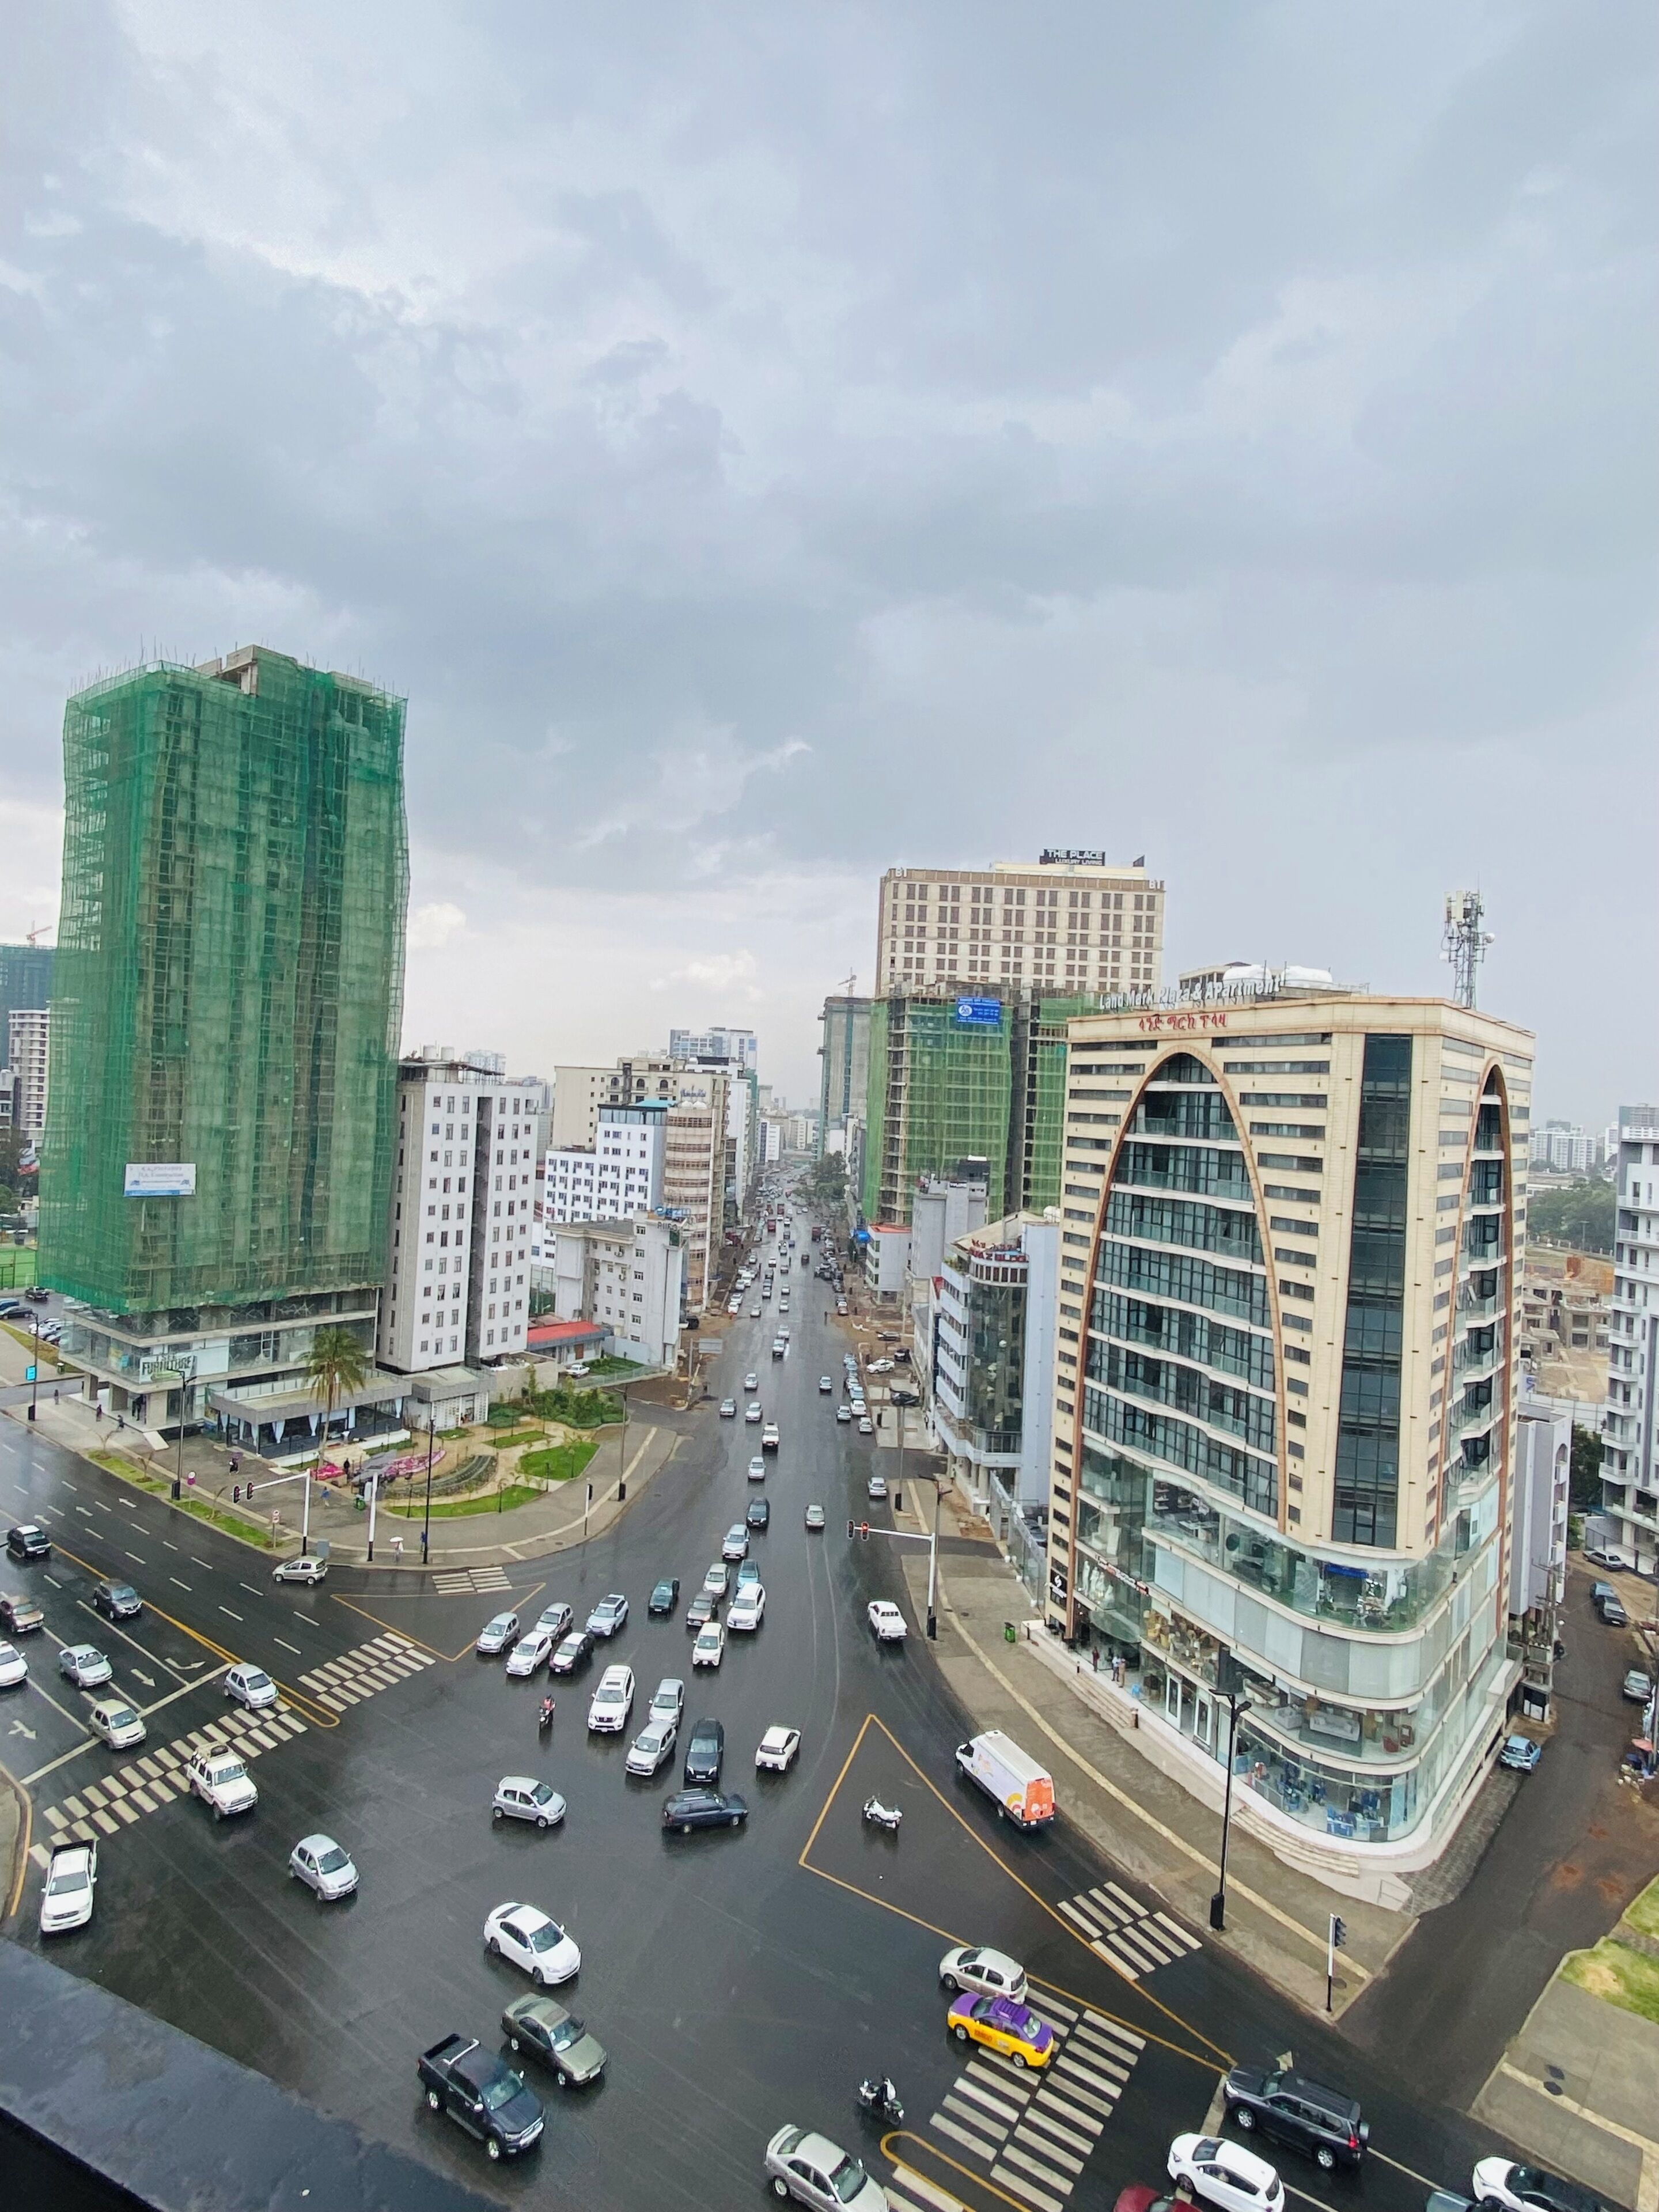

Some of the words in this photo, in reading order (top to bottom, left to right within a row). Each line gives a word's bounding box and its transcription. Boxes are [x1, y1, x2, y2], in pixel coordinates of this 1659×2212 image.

[1047, 850, 1067, 858] THE
[1070, 850, 1103, 859] PLACE
[1100, 992, 1124, 1010] Land
[1126, 988, 1154, 1006] Mark
[1158, 986, 1191, 1004] Plaza
[1191, 982, 1202, 1001] &
